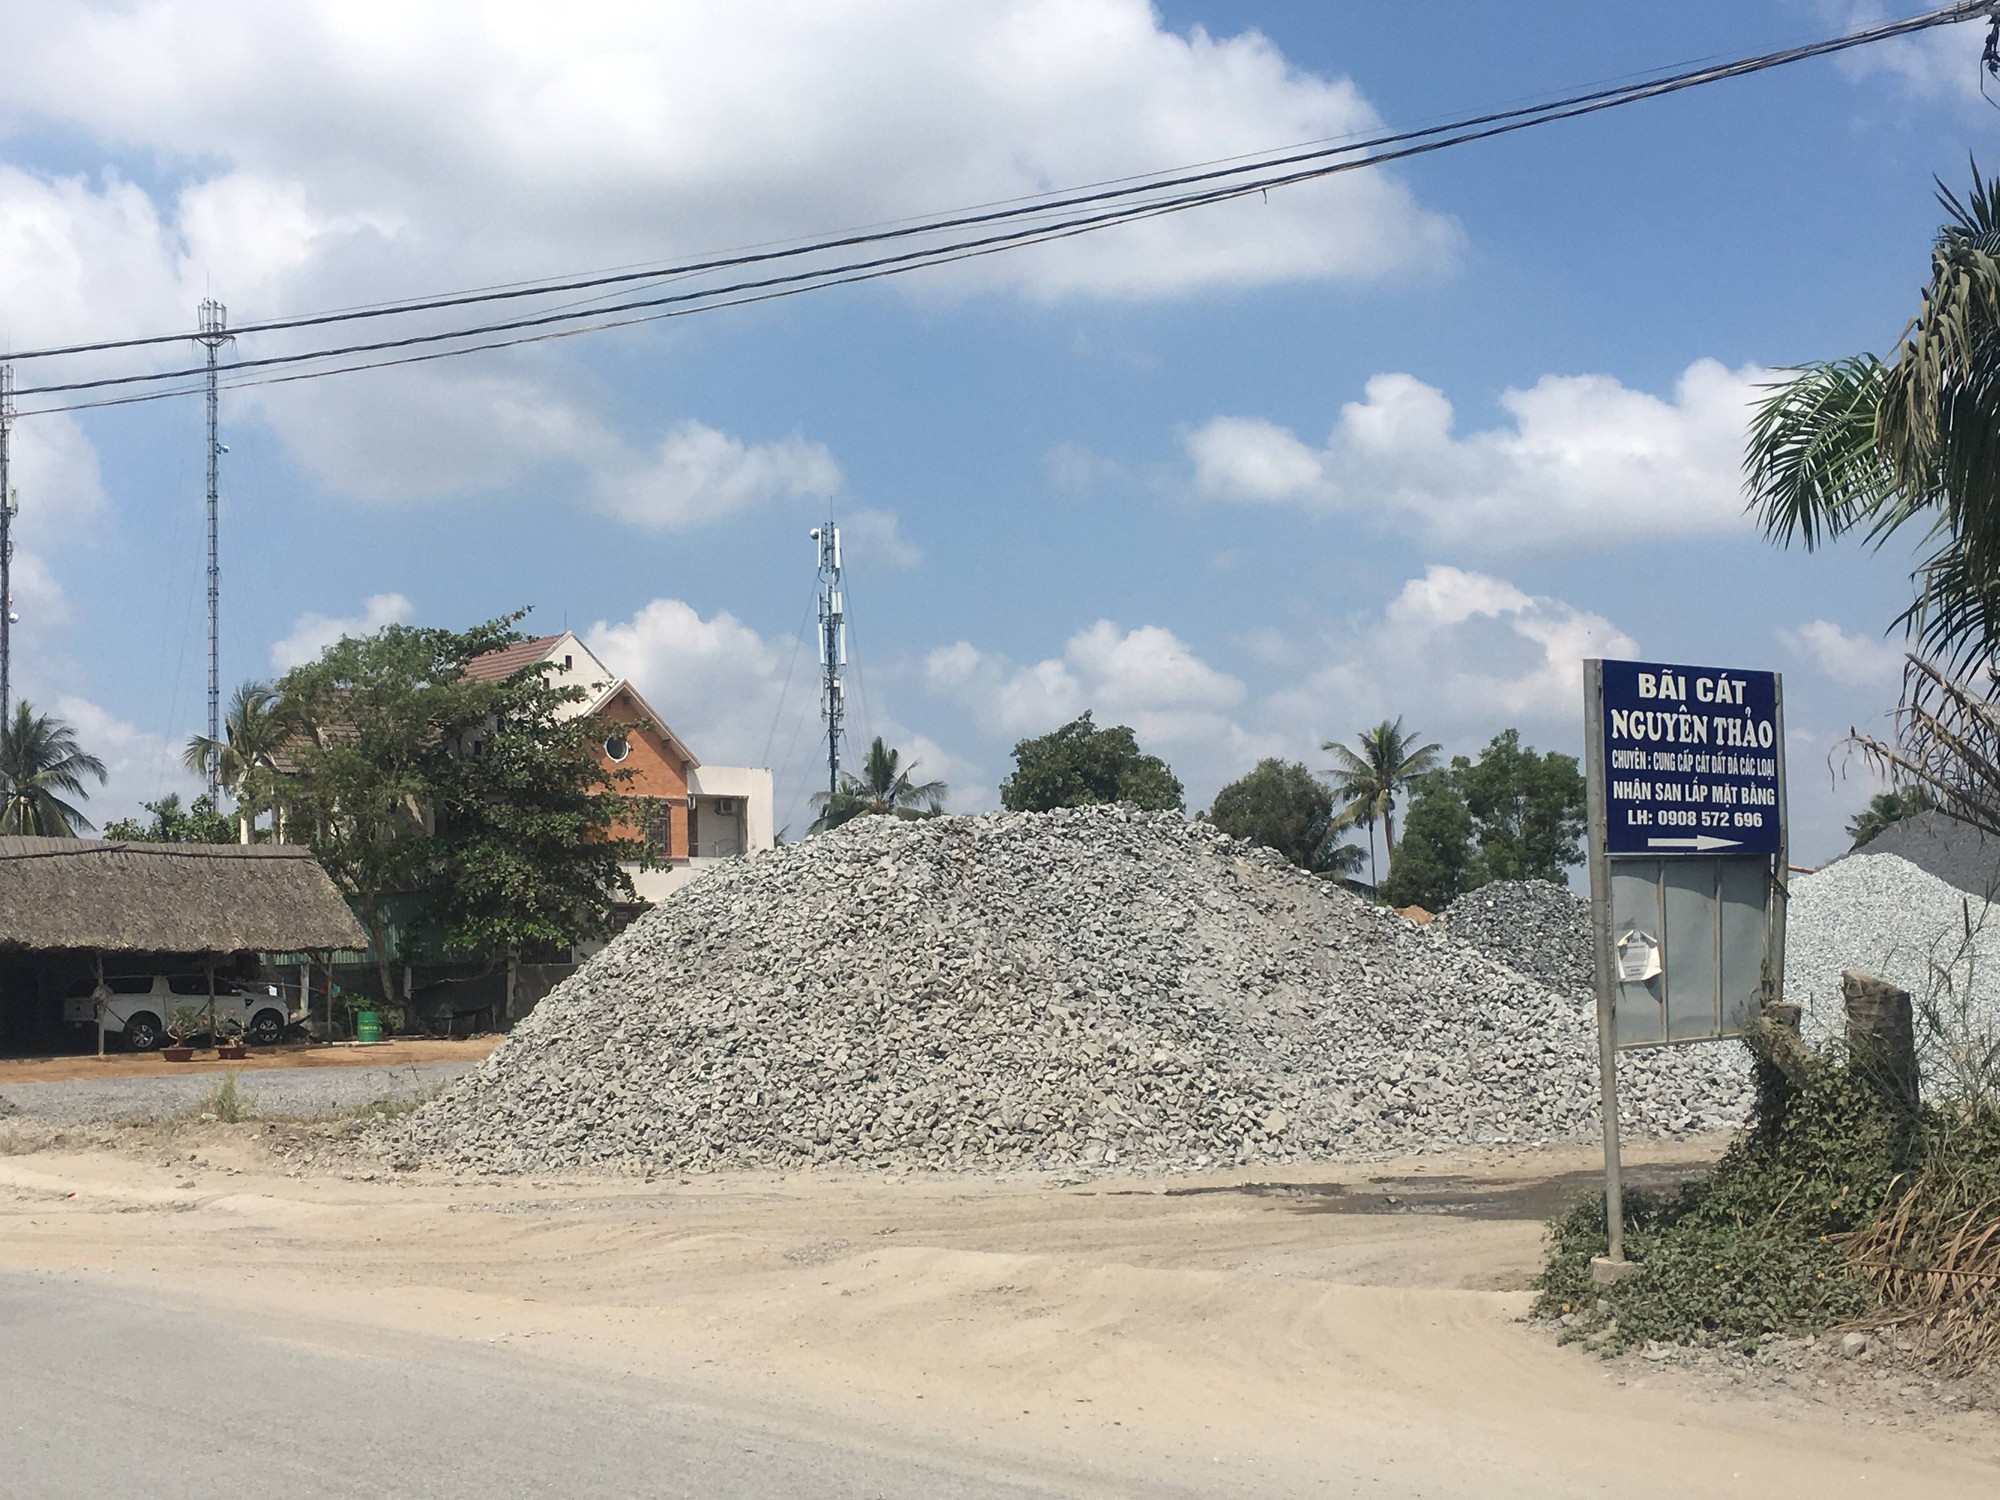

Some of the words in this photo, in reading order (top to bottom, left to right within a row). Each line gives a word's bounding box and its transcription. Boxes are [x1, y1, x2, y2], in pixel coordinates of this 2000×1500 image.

[1638, 669, 1686, 701] BÃI
[1696, 672, 1747, 704] CÁT
[1610, 704, 1708, 744] NGUYÊN
[1713, 706, 1773, 748] THẢO
[1612, 747, 1646, 770] CHUYÊN
[1653, 752, 1676, 771] CUNG
[1677, 748, 1694, 772] CẤP
[1695, 750, 1710, 774] CÁT
[1740, 754, 1756, 776] CÁC
[1757, 758, 1775, 781] LOẠI
[1613, 778, 1652, 804] NHẬN
[1655, 782, 1682, 802] SAN
[1685, 776, 1708, 803] LẤP
[1712, 783, 1738, 808] MẶT
[1628, 809, 1653, 825] LH:
[1658, 810, 1697, 826] 0908
[1701, 811, 1730, 827] 572
[1734, 812, 1763, 828] 696
